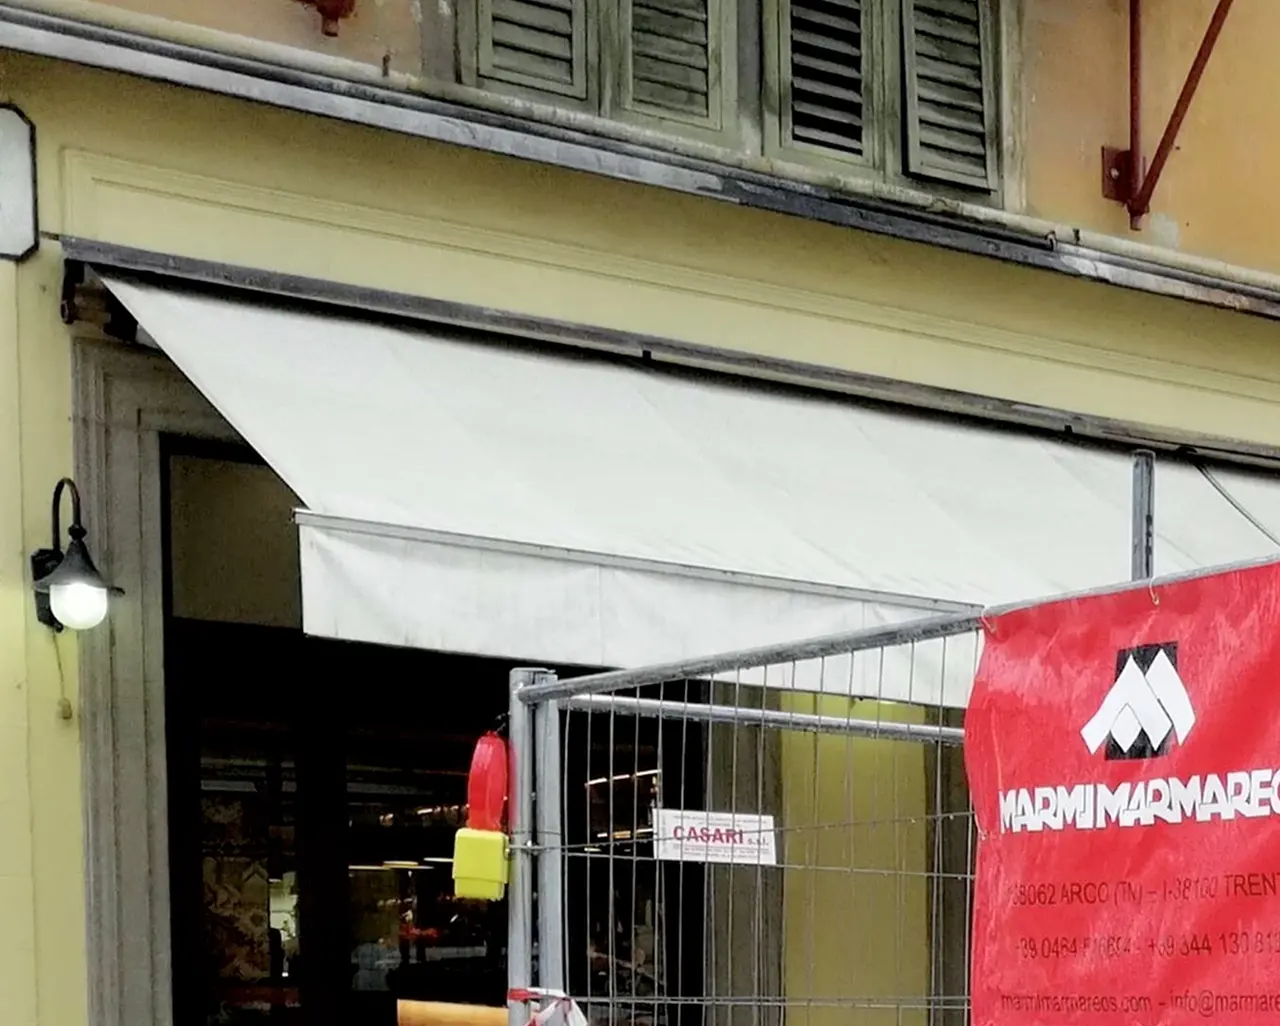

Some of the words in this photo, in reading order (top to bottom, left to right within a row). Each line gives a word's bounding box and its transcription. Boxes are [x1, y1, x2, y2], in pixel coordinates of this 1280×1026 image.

[999, 783, 1095, 834] MARMI
[673, 825, 744, 844] CASARI
[1061, 881, 1109, 905] ARCO
